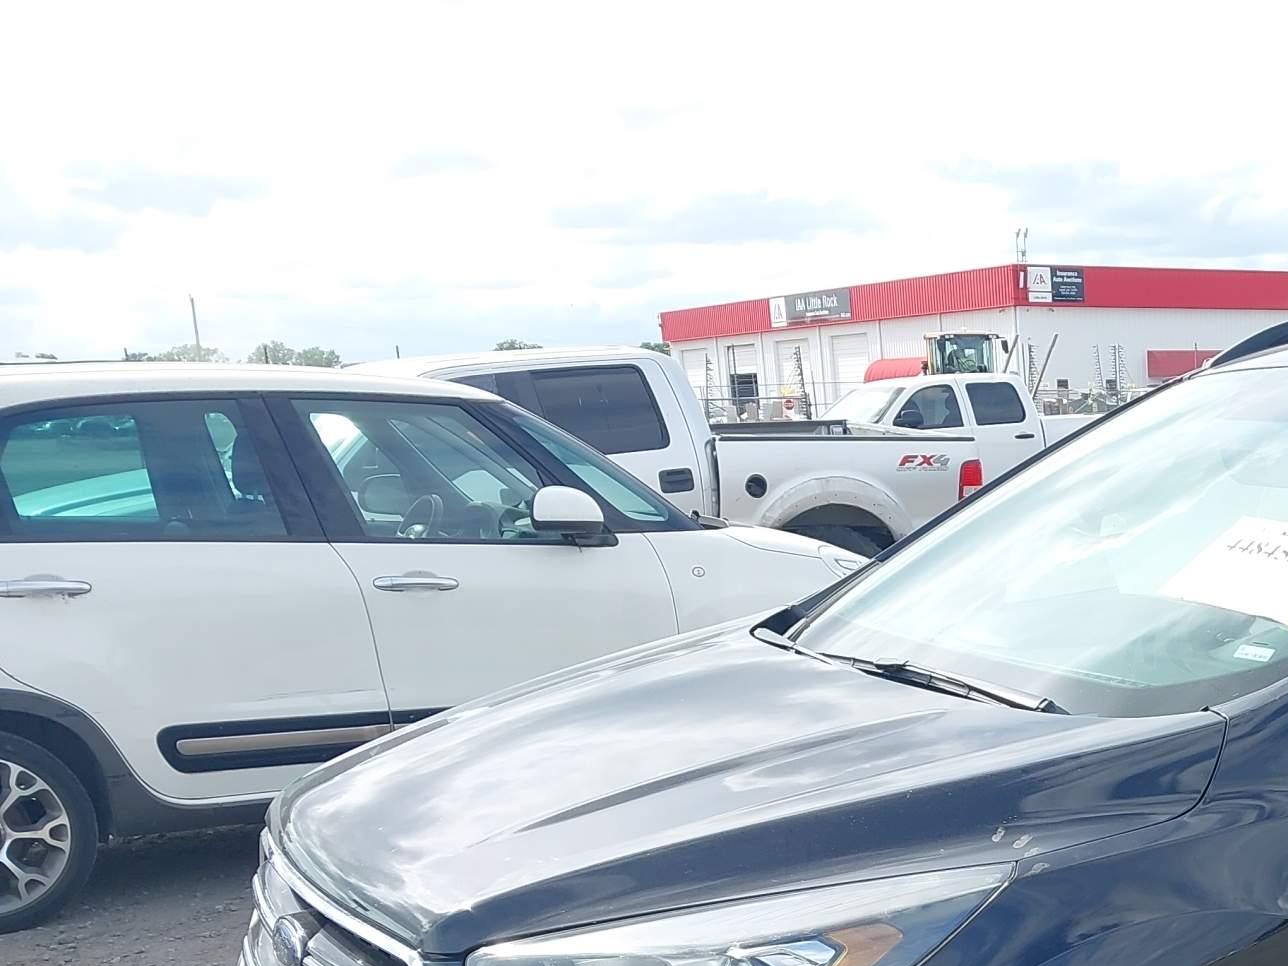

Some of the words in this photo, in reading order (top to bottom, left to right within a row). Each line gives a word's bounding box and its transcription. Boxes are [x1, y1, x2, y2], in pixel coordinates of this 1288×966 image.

[806, 294, 821, 310] Little
[822, 293, 838, 308] Rock
[898, 454, 950, 466] FX4
